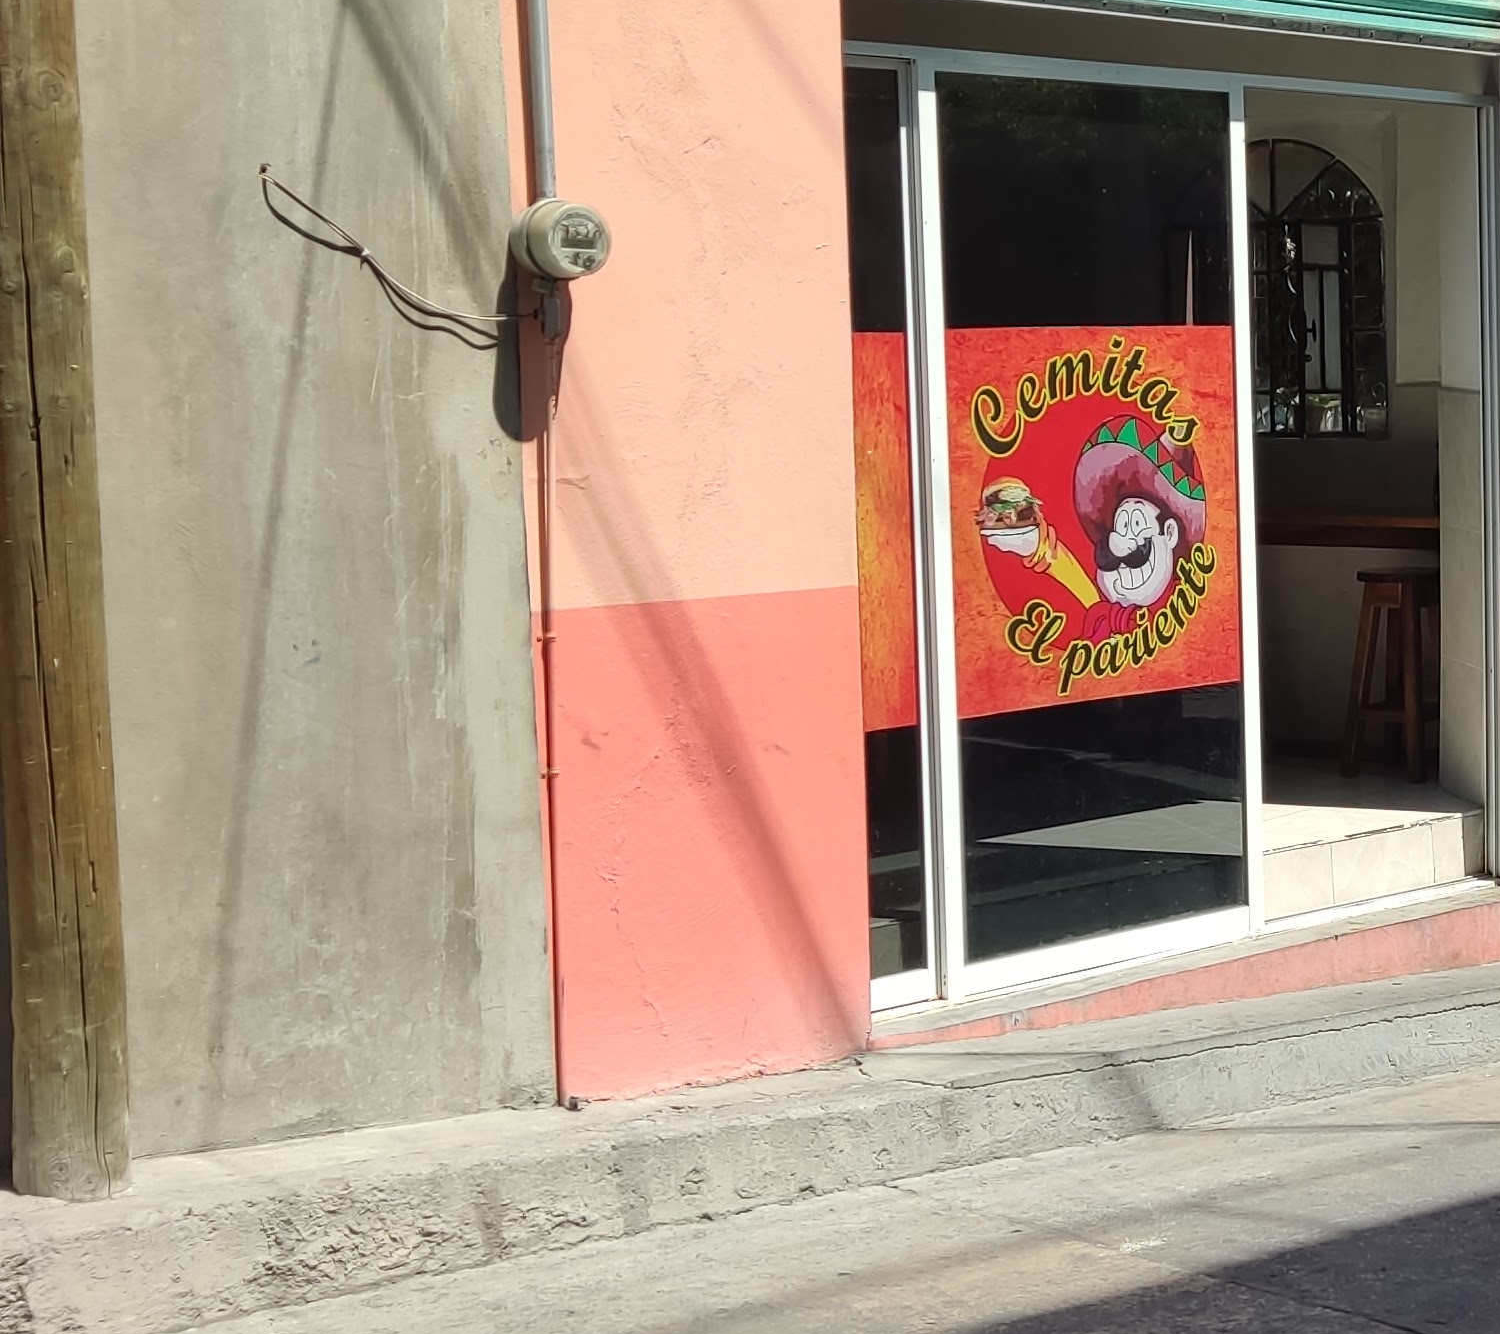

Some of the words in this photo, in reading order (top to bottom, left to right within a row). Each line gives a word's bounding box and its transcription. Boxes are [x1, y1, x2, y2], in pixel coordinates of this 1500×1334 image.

[971, 335, 1200, 456] Cemitas
[1004, 599, 1068, 666] El
[1057, 540, 1218, 697] pariente
